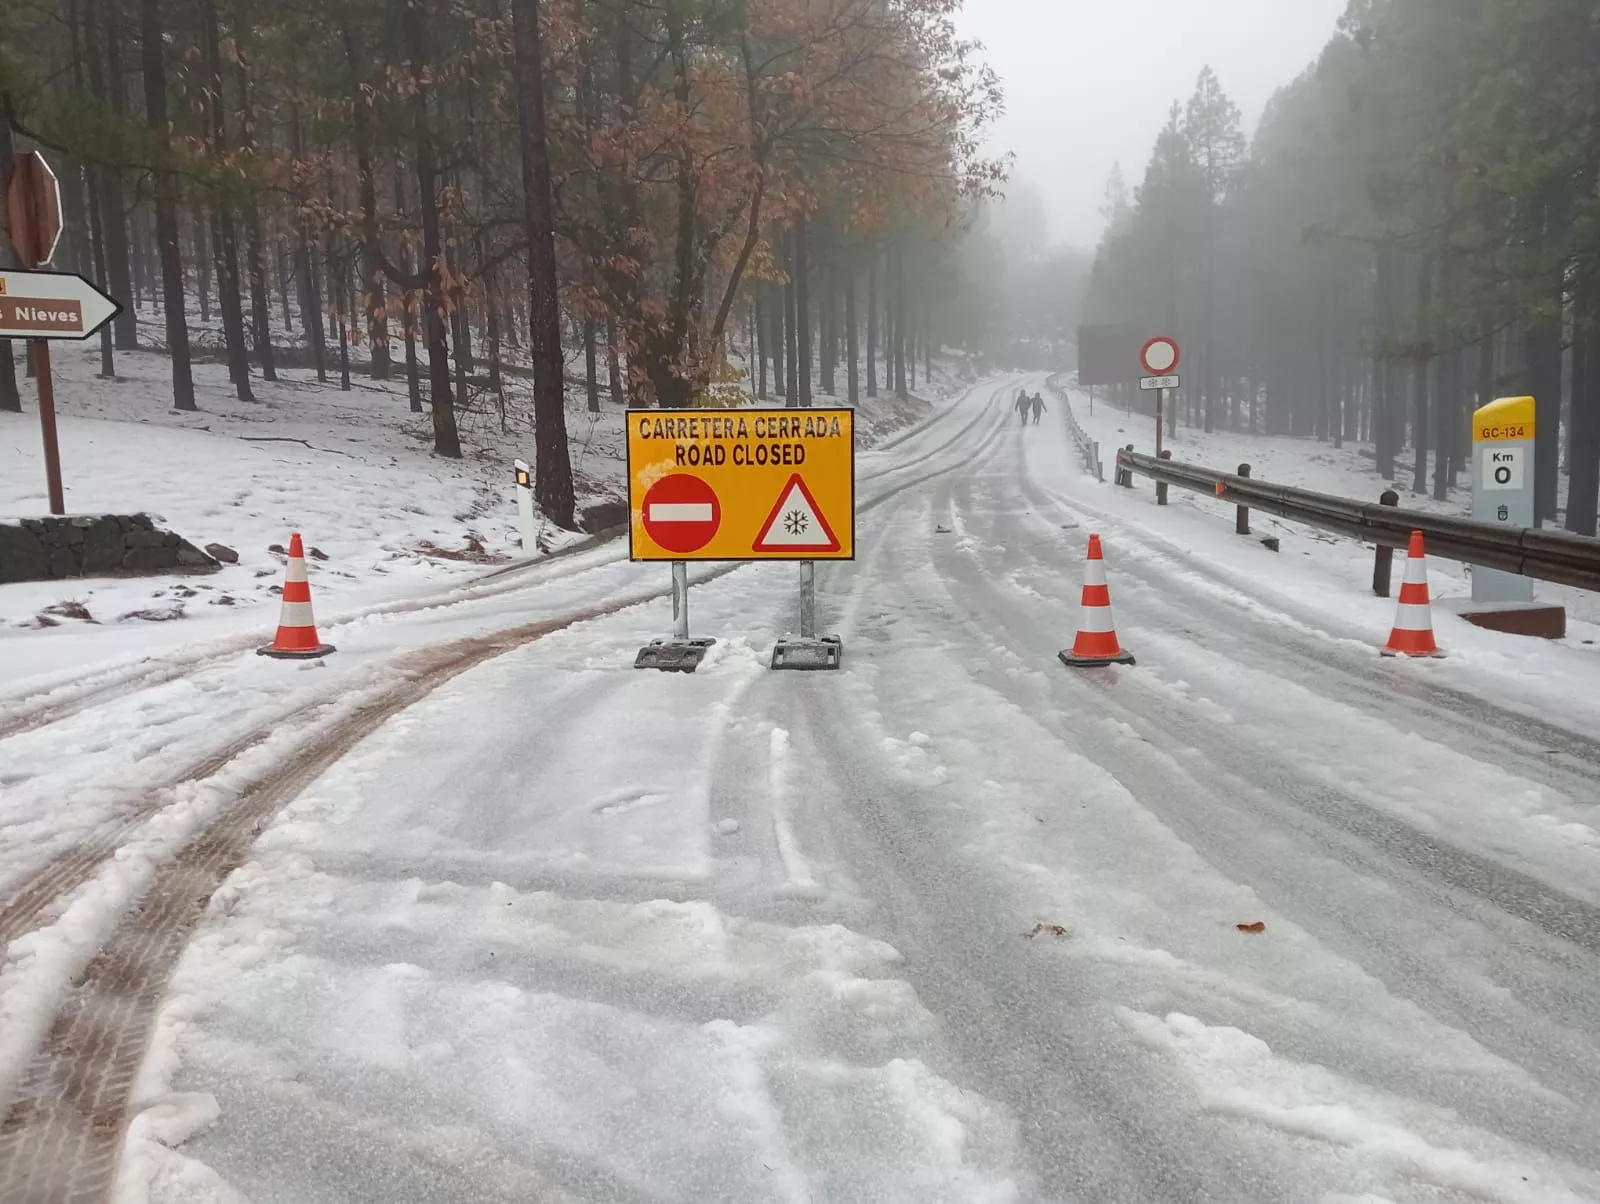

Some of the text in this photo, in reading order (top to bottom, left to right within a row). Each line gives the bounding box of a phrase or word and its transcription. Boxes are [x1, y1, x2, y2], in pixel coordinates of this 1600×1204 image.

[15, 307, 78, 321] Nieves
[639, 416, 841, 439] CARRETERA CERRADA
[1482, 427, 1524, 438] GC-134
[675, 443, 805, 466] ROAD CLOSED
[1492, 452, 1514, 462] Km
[1494, 466, 1511, 484] 0
